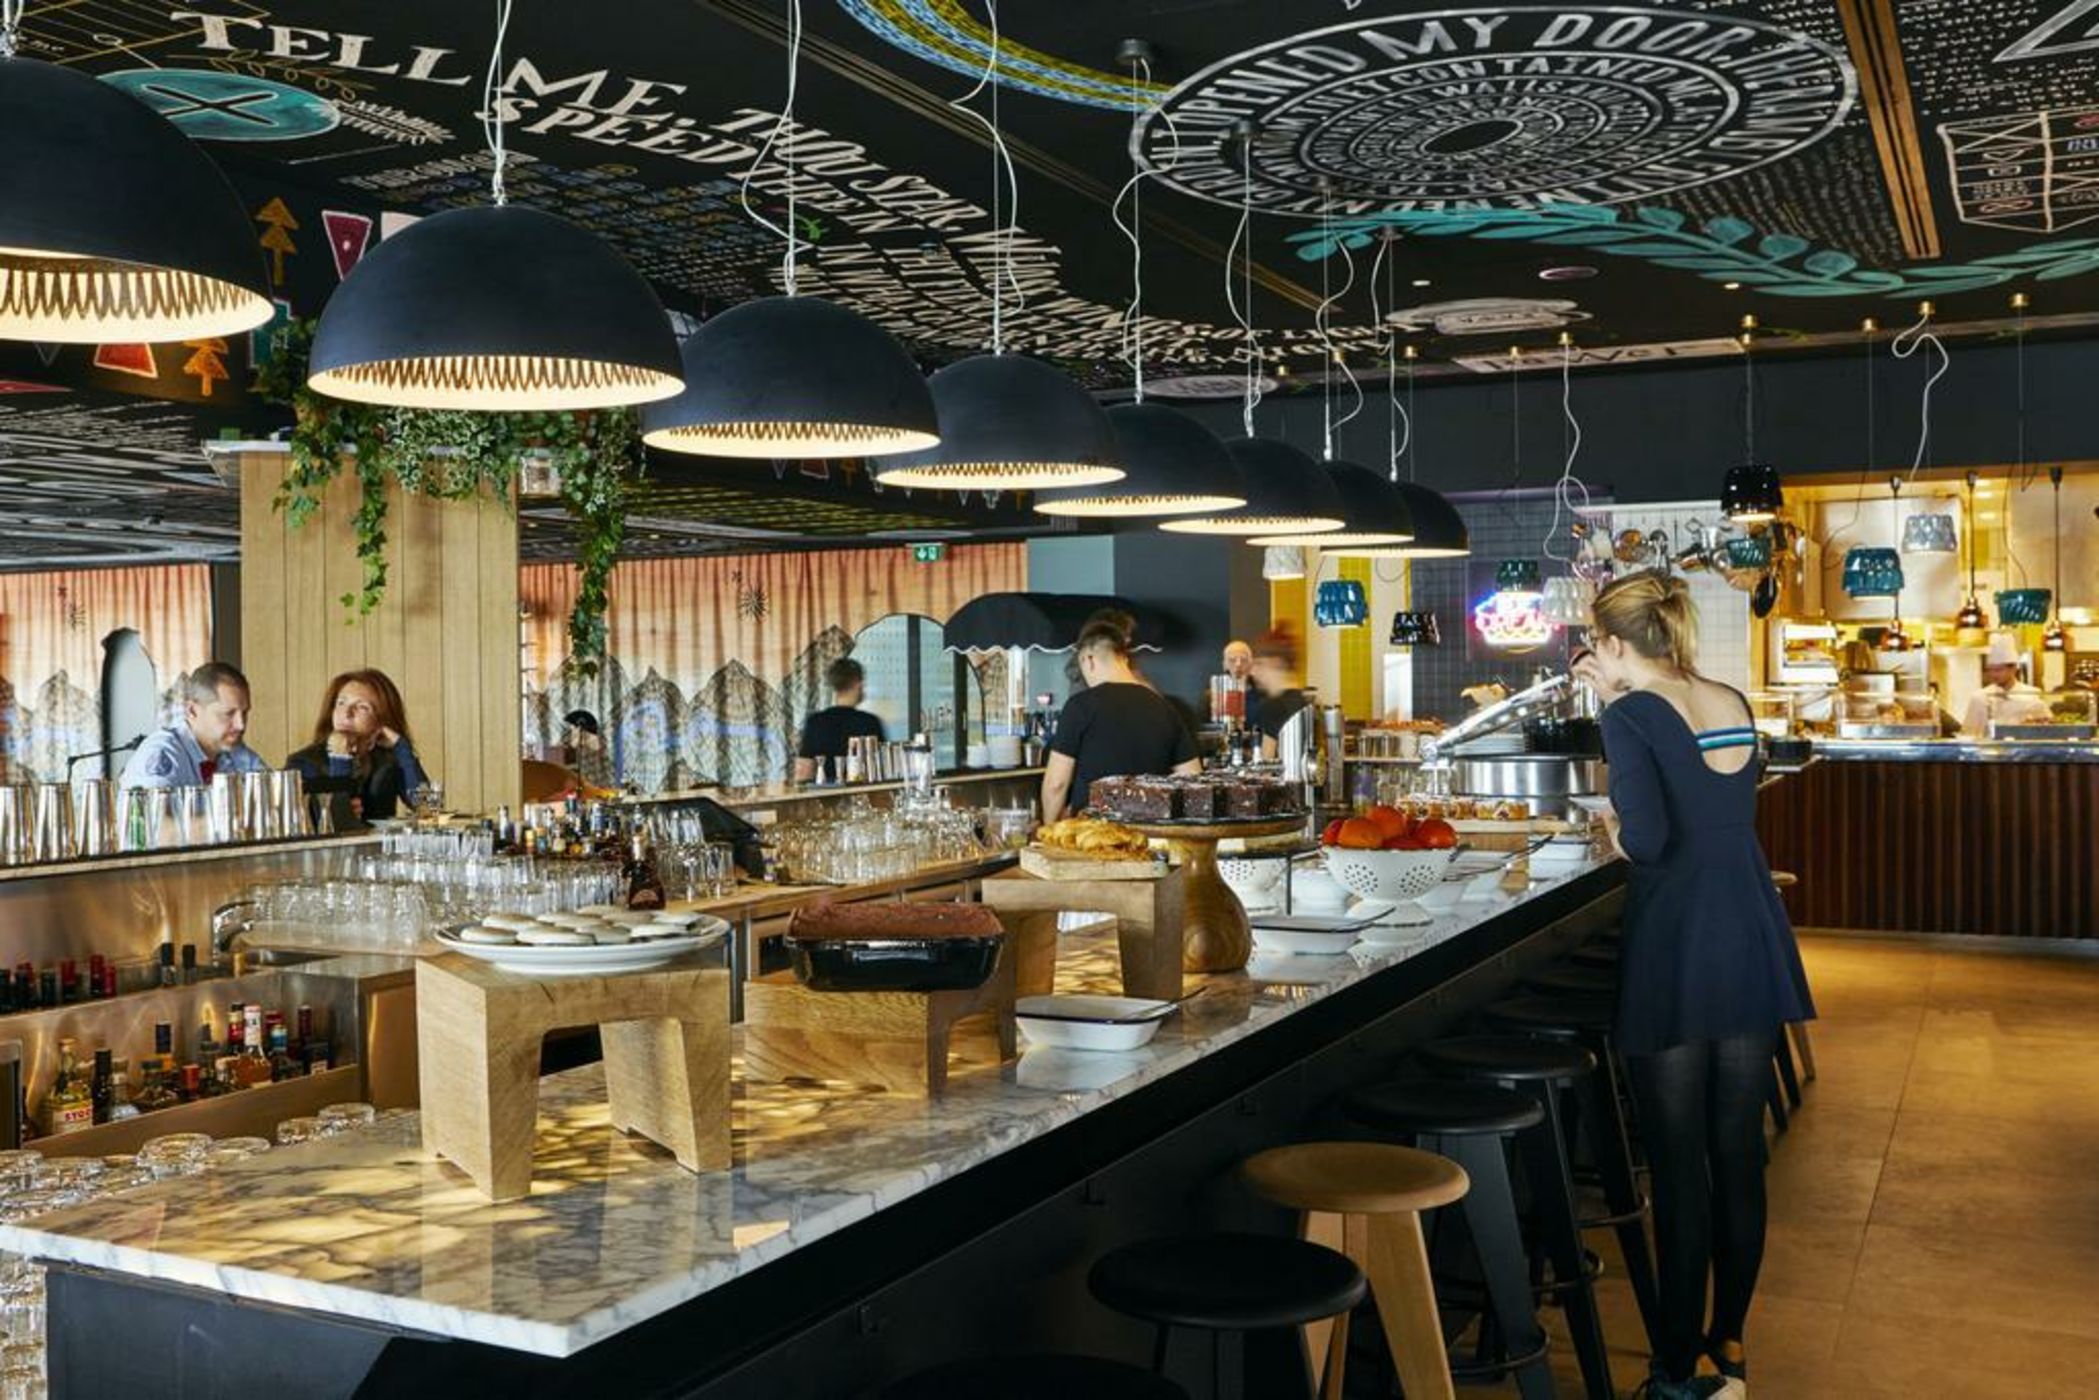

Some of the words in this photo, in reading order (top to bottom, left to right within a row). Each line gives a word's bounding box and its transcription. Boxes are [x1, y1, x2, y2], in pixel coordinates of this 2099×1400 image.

[170, 11, 472, 86] TELL
[709, 108, 889, 176] THOU
[1165, 44, 1369, 124] OPENED
[1357, 16, 1508, 61] MY
[1388, 59, 1676, 88] CONTAINED
[474, 98, 758, 163] SPEED
[836, 211, 933, 232] IN
